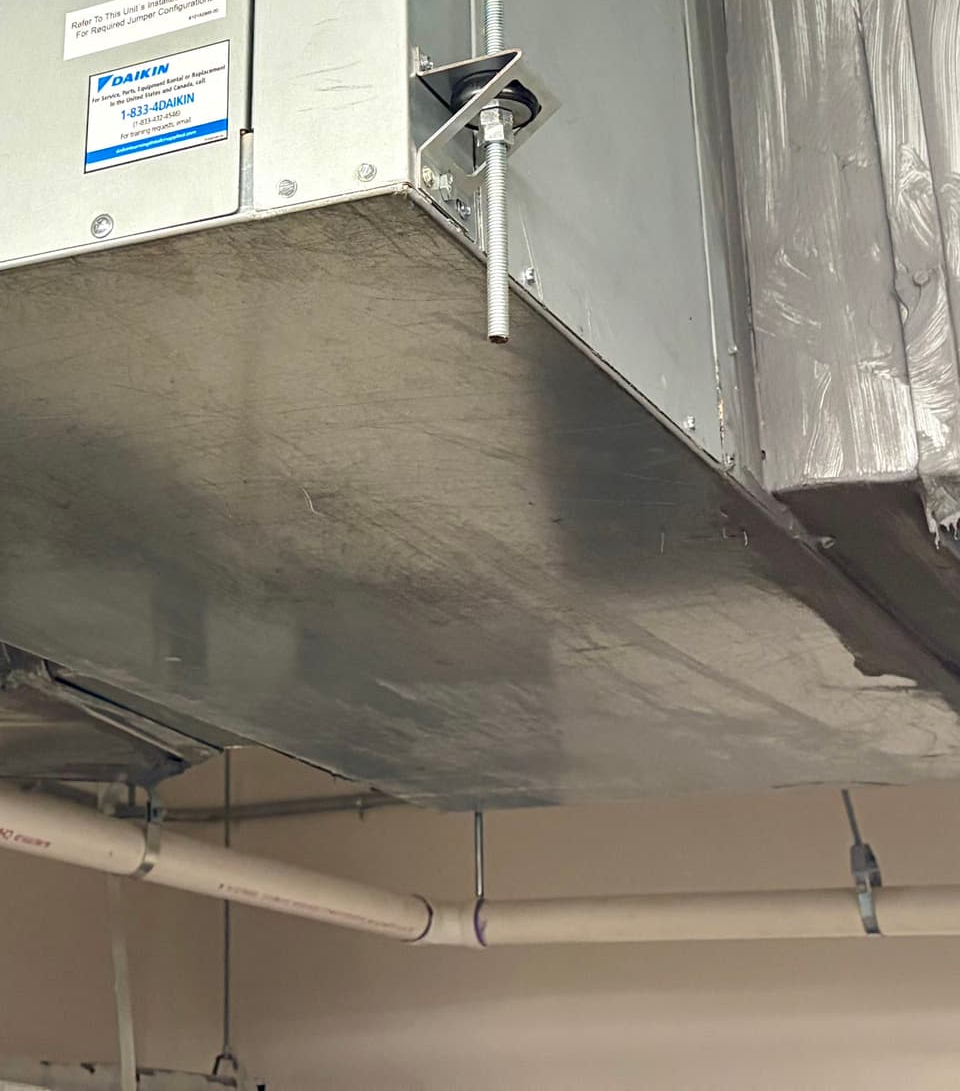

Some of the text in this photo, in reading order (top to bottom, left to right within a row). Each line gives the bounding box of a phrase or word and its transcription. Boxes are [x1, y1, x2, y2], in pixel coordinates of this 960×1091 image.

[71, 18, 92, 30] Refer
[94, 14, 103, 23] To
[105, 9, 121, 21] This
[76, 29, 89, 39] For
[90, 19, 124, 37] Required
[127, 10, 156, 27] Jumper
[111, 63, 169, 87] DAIKIN
[126, 92, 144, 103] United
[162, 86, 172, 95] and
[121, 93, 195, 121] 1-833-4DAIKIN
[120, 131, 129, 141] For
[131, 127, 150, 138] training
